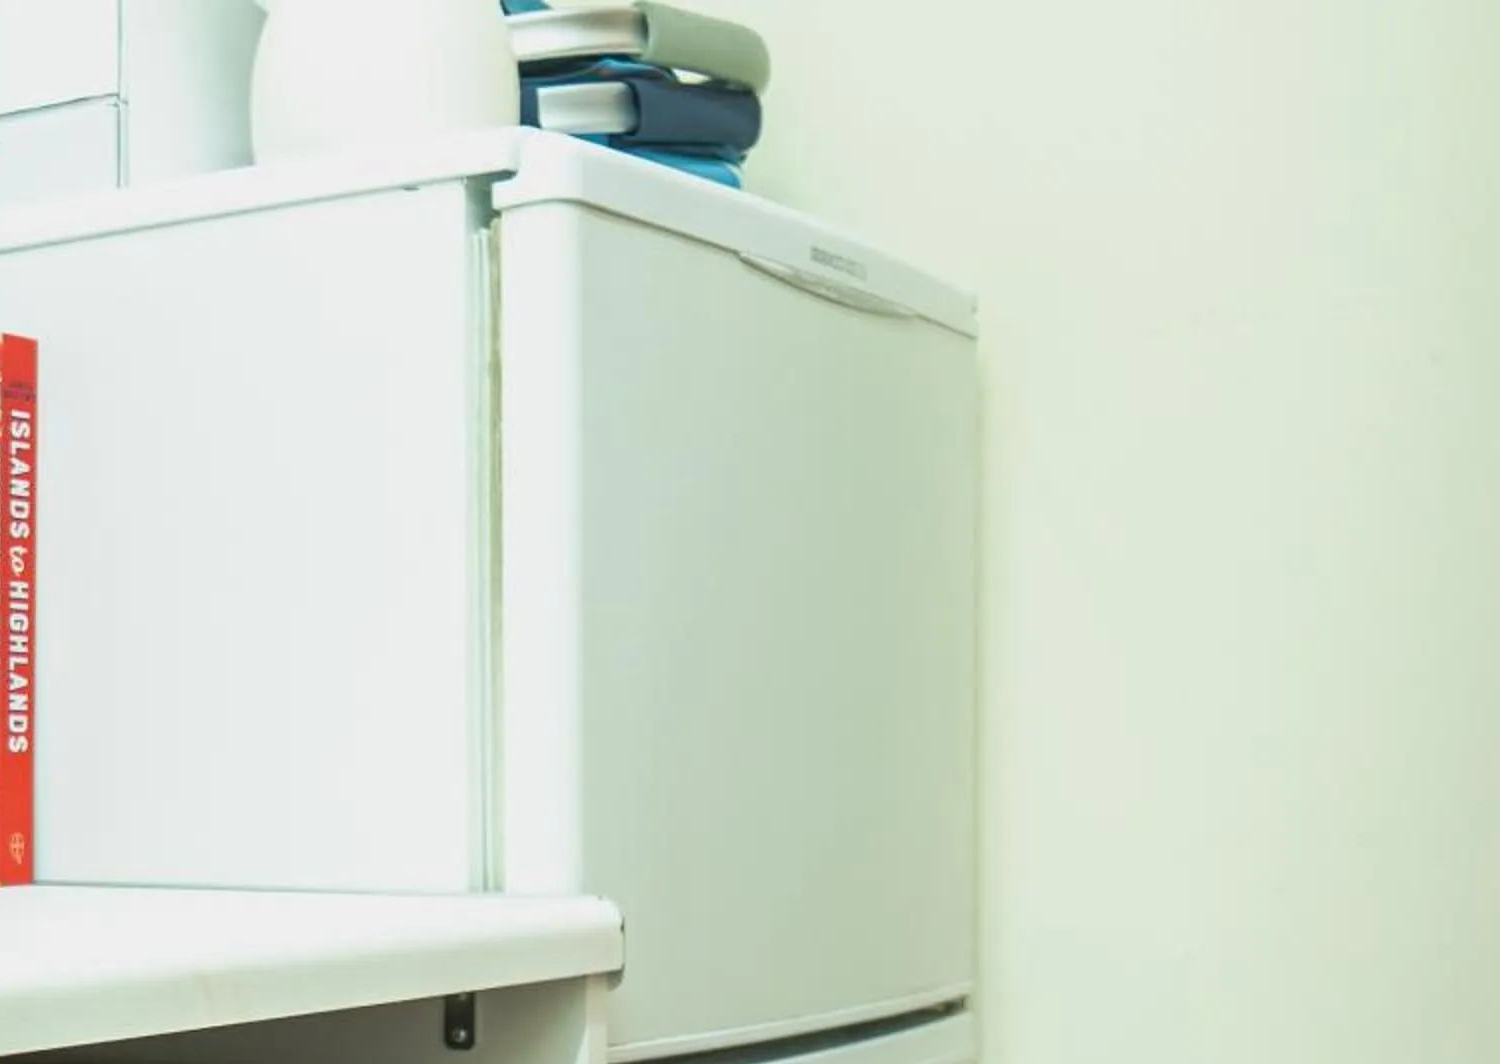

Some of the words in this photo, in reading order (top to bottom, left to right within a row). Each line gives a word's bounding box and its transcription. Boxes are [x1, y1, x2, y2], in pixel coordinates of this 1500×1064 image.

[9, 409, 30, 537] ISLANDS
[10, 545, 29, 577] to
[8, 581, 30, 753] HIGHLANDS
